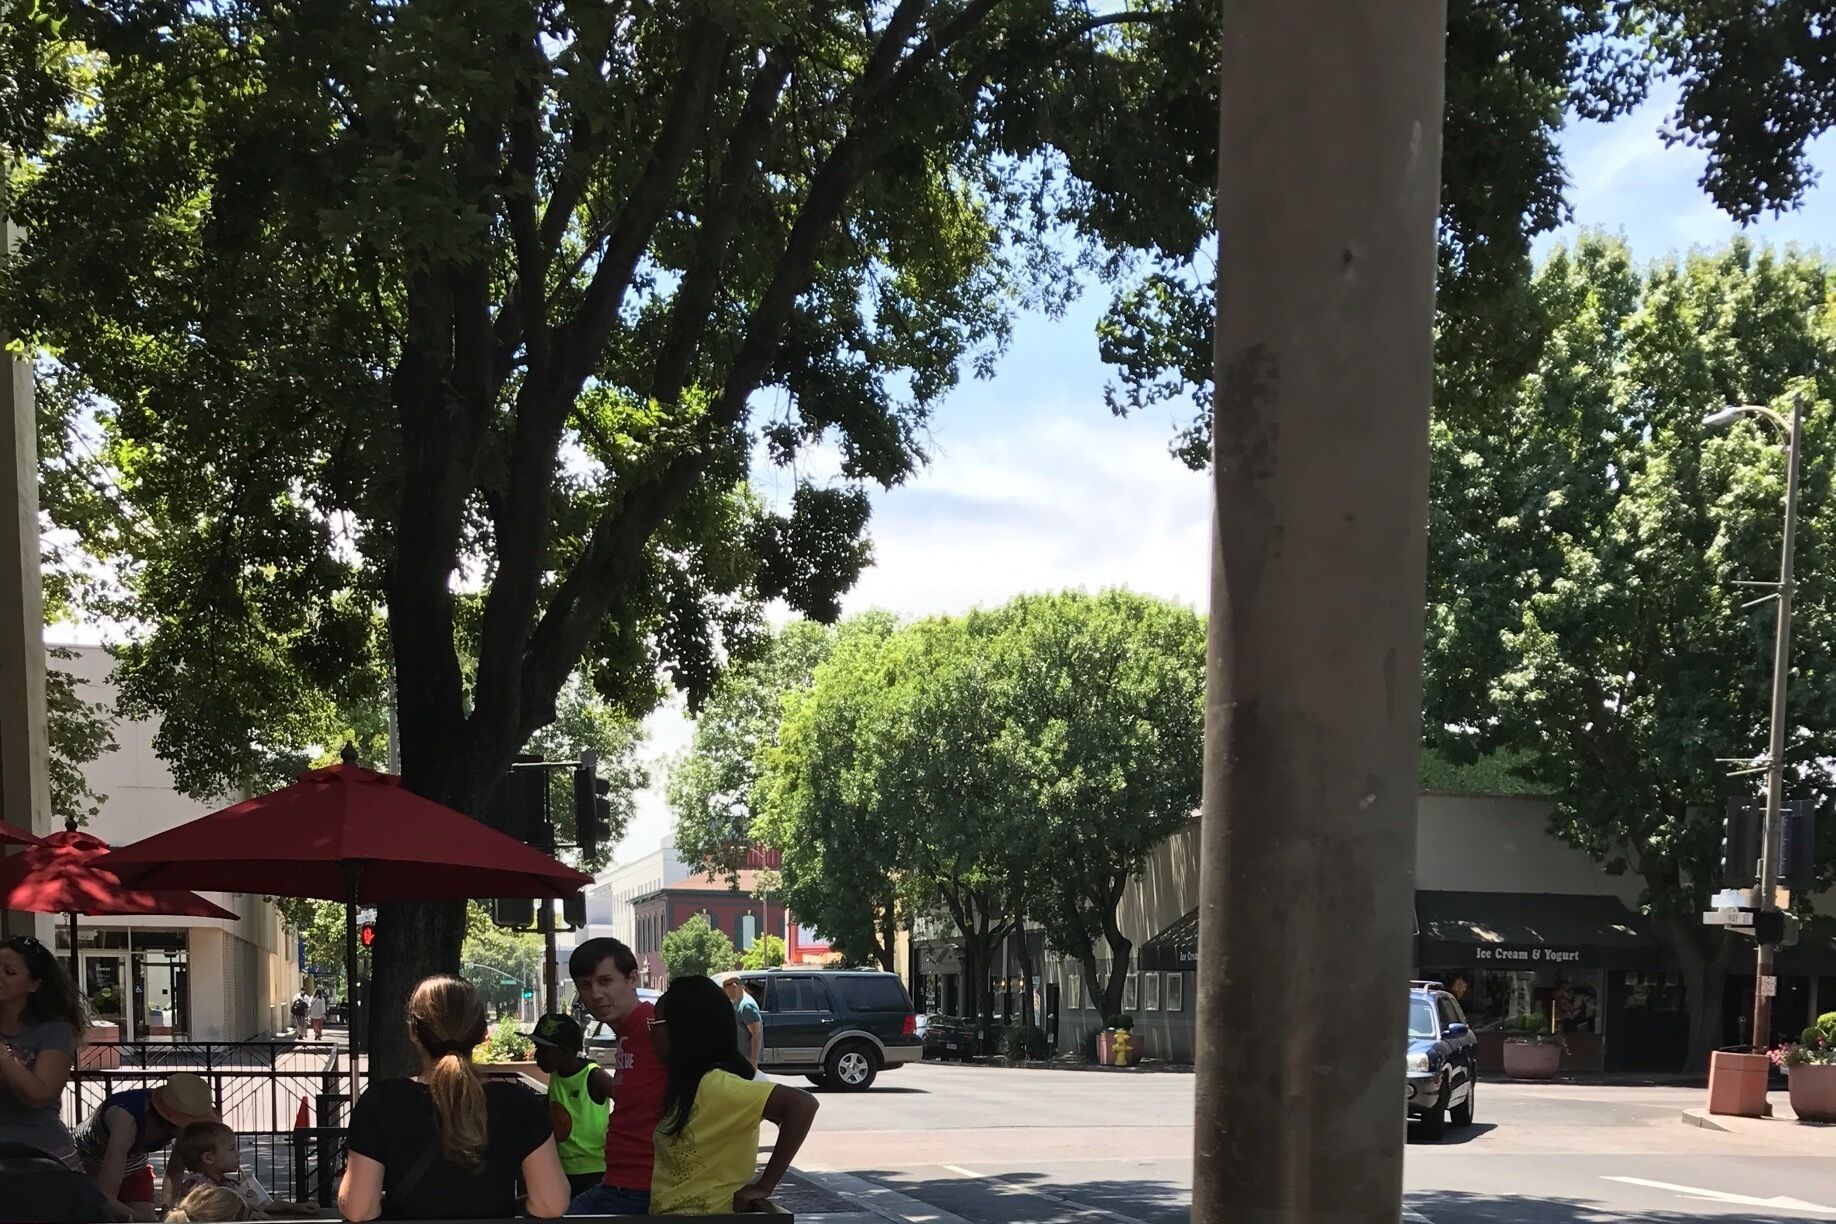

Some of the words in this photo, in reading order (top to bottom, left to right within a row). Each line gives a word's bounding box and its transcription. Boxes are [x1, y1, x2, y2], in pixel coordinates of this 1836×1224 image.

[1476, 947, 1492, 960] Ice
[1494, 948, 1529, 960] Cream
[1532, 949, 1541, 961] &
[1544, 949, 1580, 963] Yogurt
